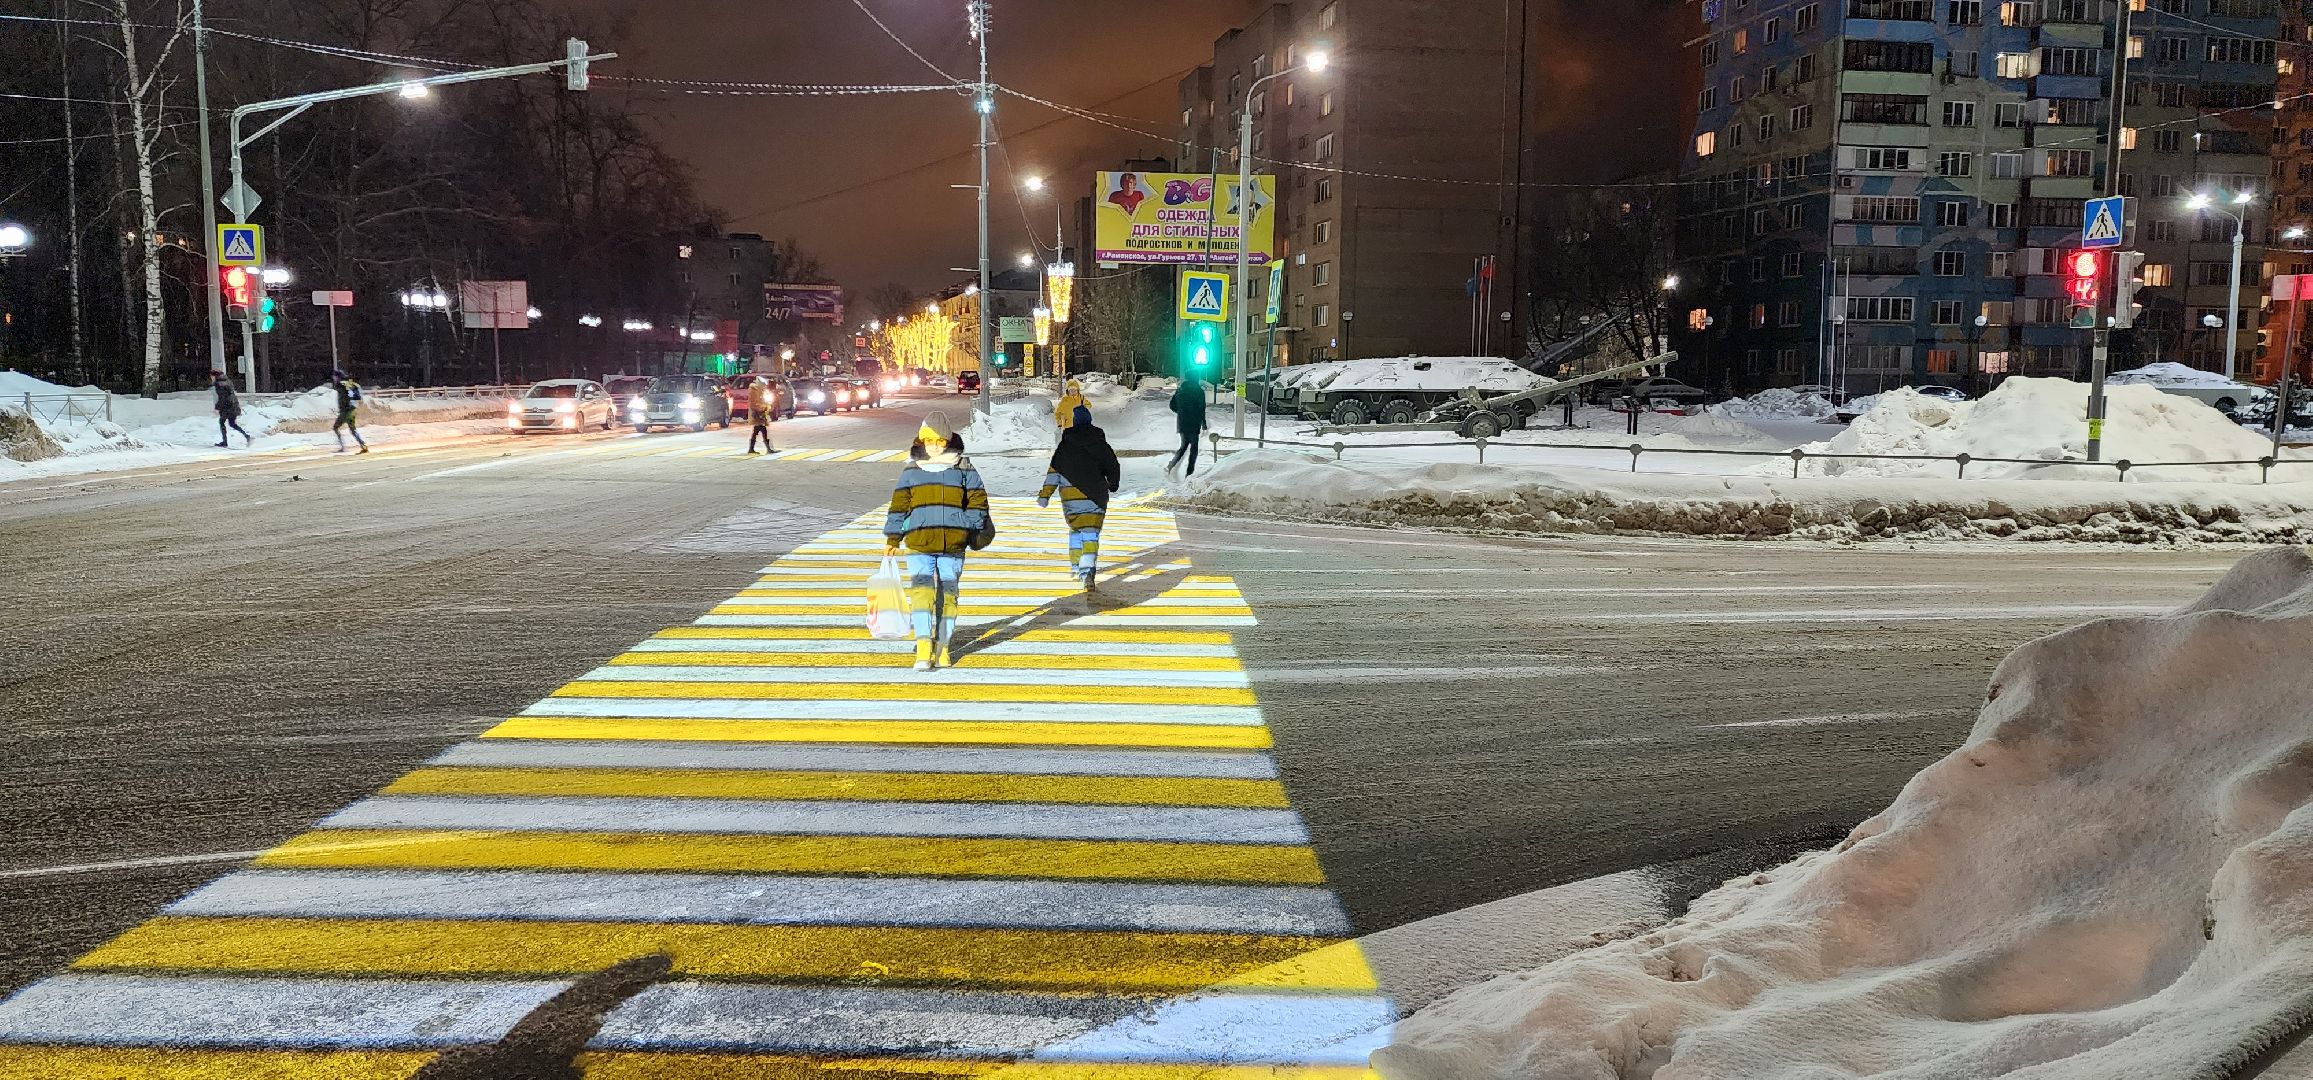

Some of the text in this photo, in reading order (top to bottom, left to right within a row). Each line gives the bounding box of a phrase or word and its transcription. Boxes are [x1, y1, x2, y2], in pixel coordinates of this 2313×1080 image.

[1157, 209, 1216, 222] ОДЕЖДА
[1132, 225, 1240, 237] ДЛЯ СТИЛЬНЫХ
[1125, 239, 1240, 250] ПОДРОСТКОВ И МЛОДЕ
[765, 307, 791, 320] 24/7
[1002, 318, 1025, 326] ОКНА
